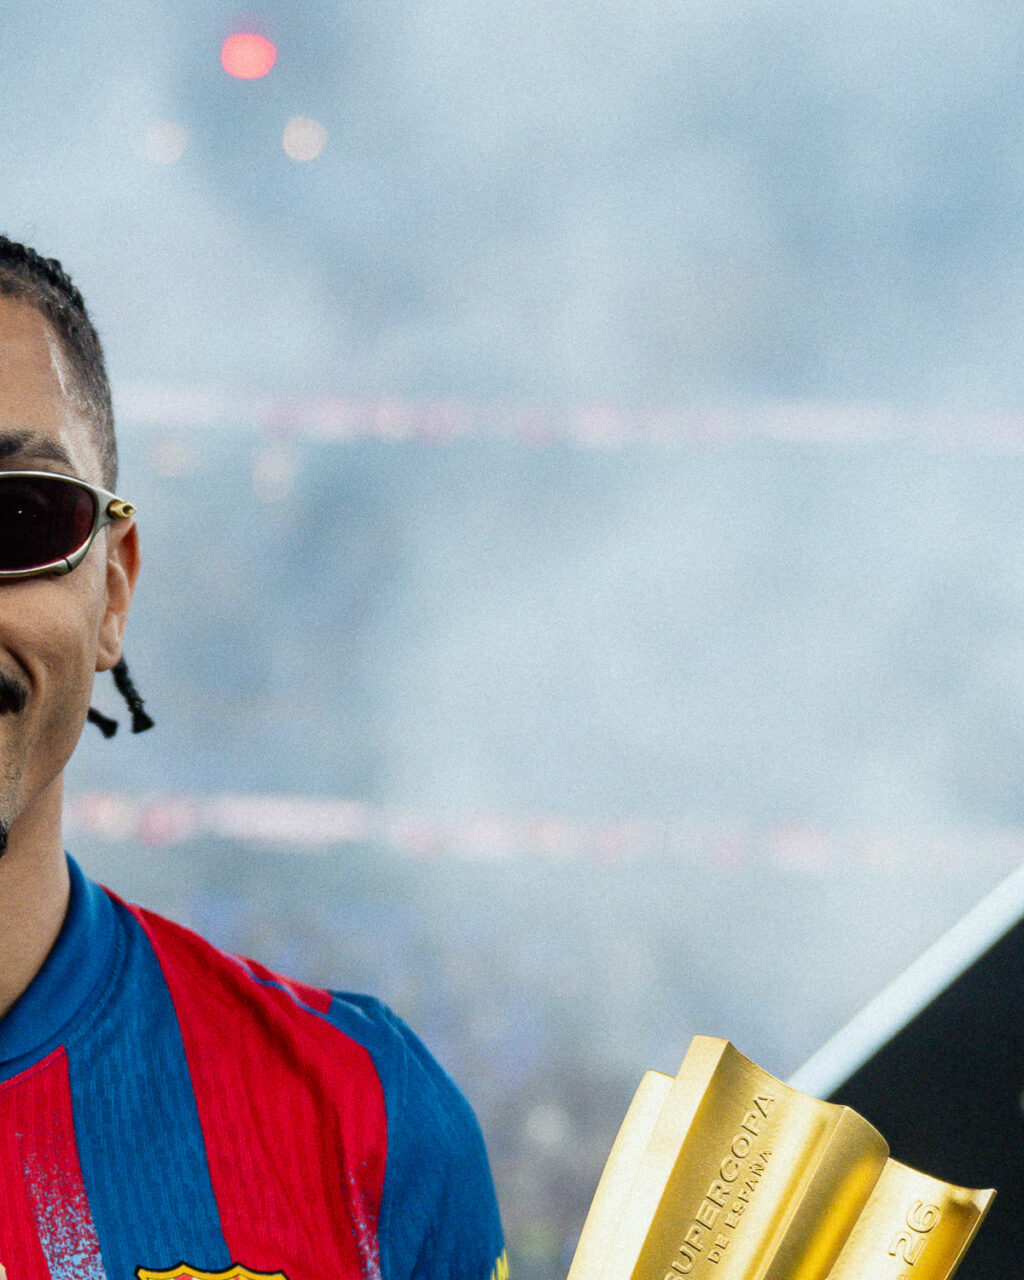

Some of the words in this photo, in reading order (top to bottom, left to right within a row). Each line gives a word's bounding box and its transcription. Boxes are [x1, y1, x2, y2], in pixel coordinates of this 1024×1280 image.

[708, 1234, 730, 1265] DE
[725, 1150, 773, 1229] ESPAÑA
[888, 1199, 942, 1266] 26
